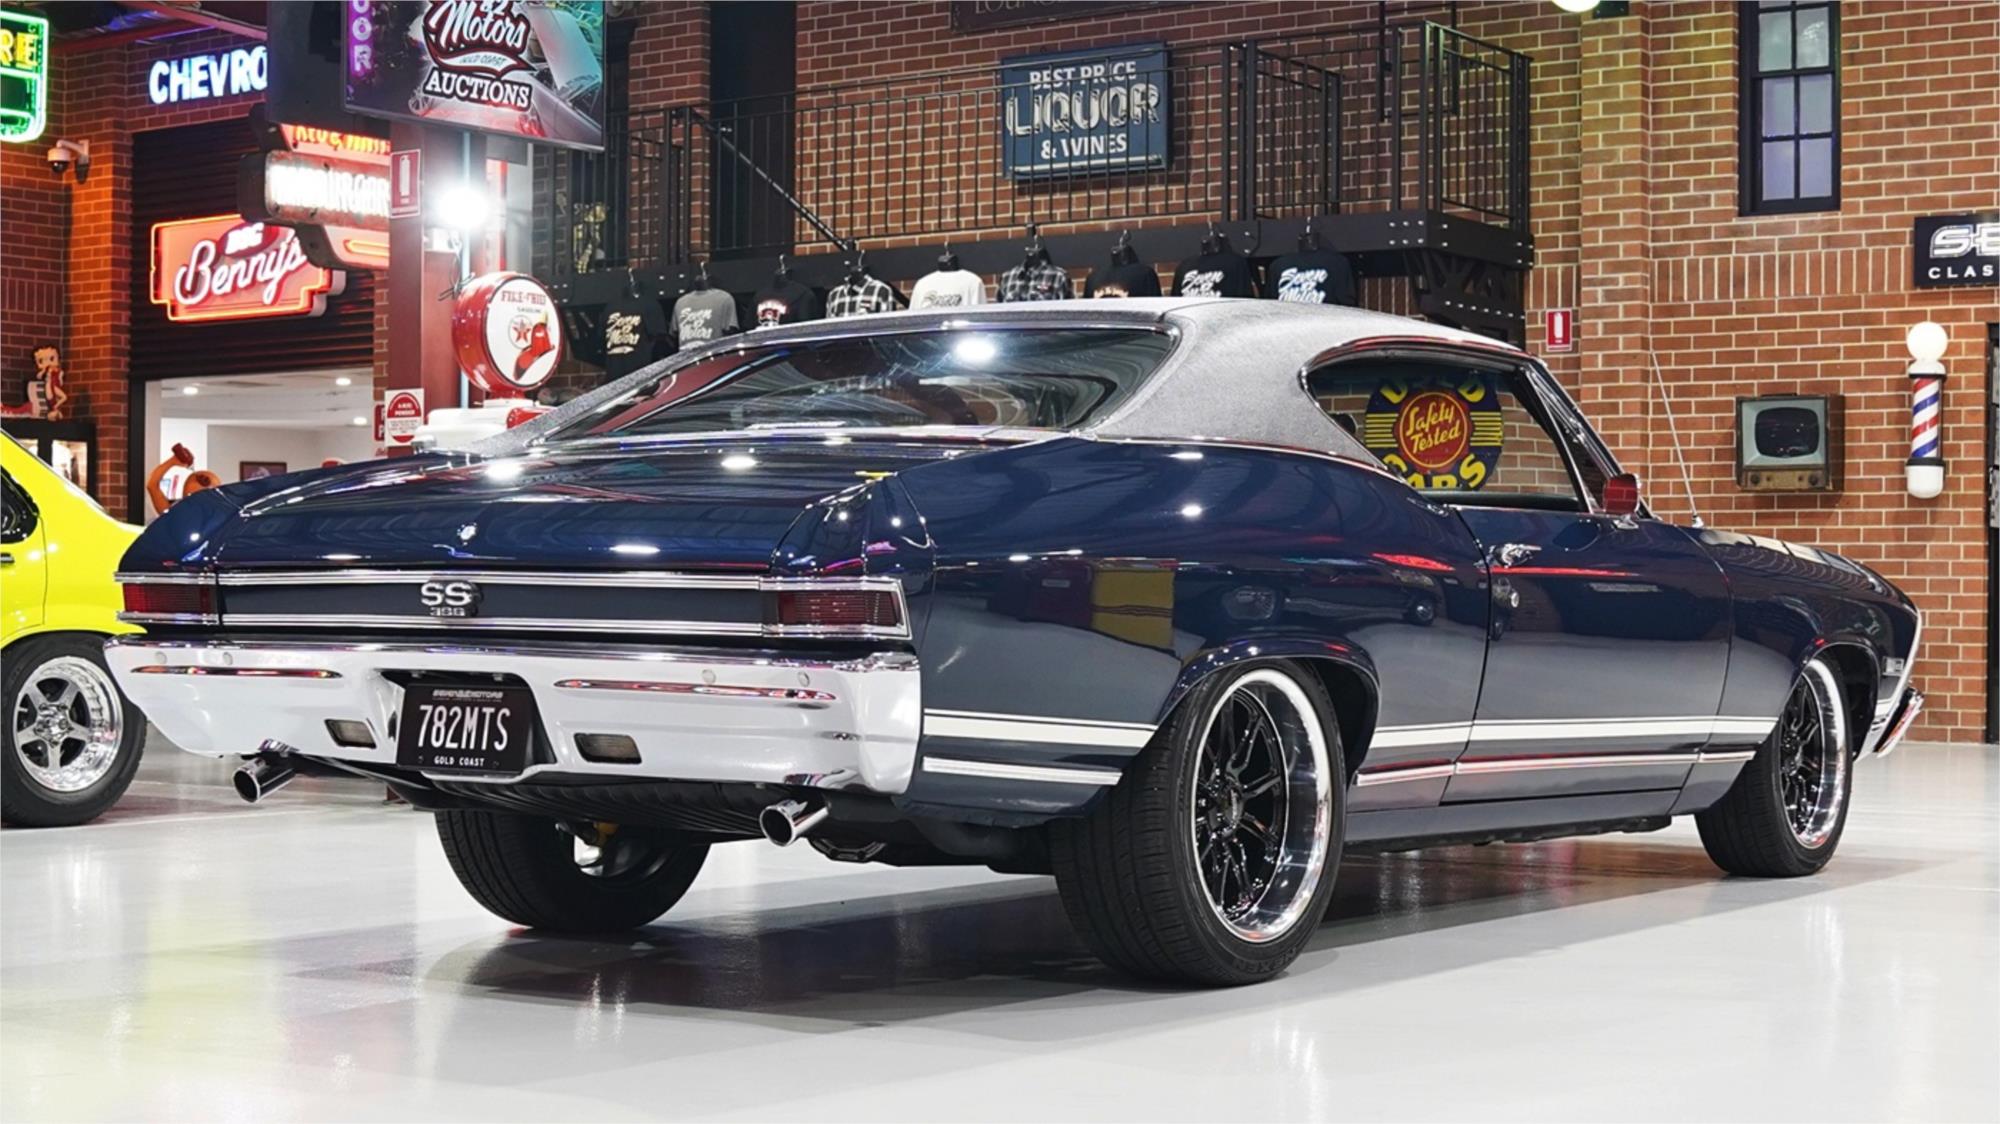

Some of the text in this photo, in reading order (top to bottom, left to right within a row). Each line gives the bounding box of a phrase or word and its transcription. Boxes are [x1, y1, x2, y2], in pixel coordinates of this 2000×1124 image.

[428, 0, 527, 50] Motors
[149, 45, 268, 104] CHEVRO
[425, 69, 530, 108] AUCTIONS
[1029, 67, 1076, 90] BEST
[1005, 83, 1160, 136] LIQUOR
[1040, 133, 1128, 160] & WINES
[174, 231, 308, 305] Benny's
[1927, 264, 1994, 280] CLAS
[1406, 402, 1455, 437] Safety
[1410, 419, 1461, 454] Tested
[421, 582, 472, 606] SS
[417, 704, 511, 751] 782MTS
[433, 755, 485, 767] GOLD COAST
